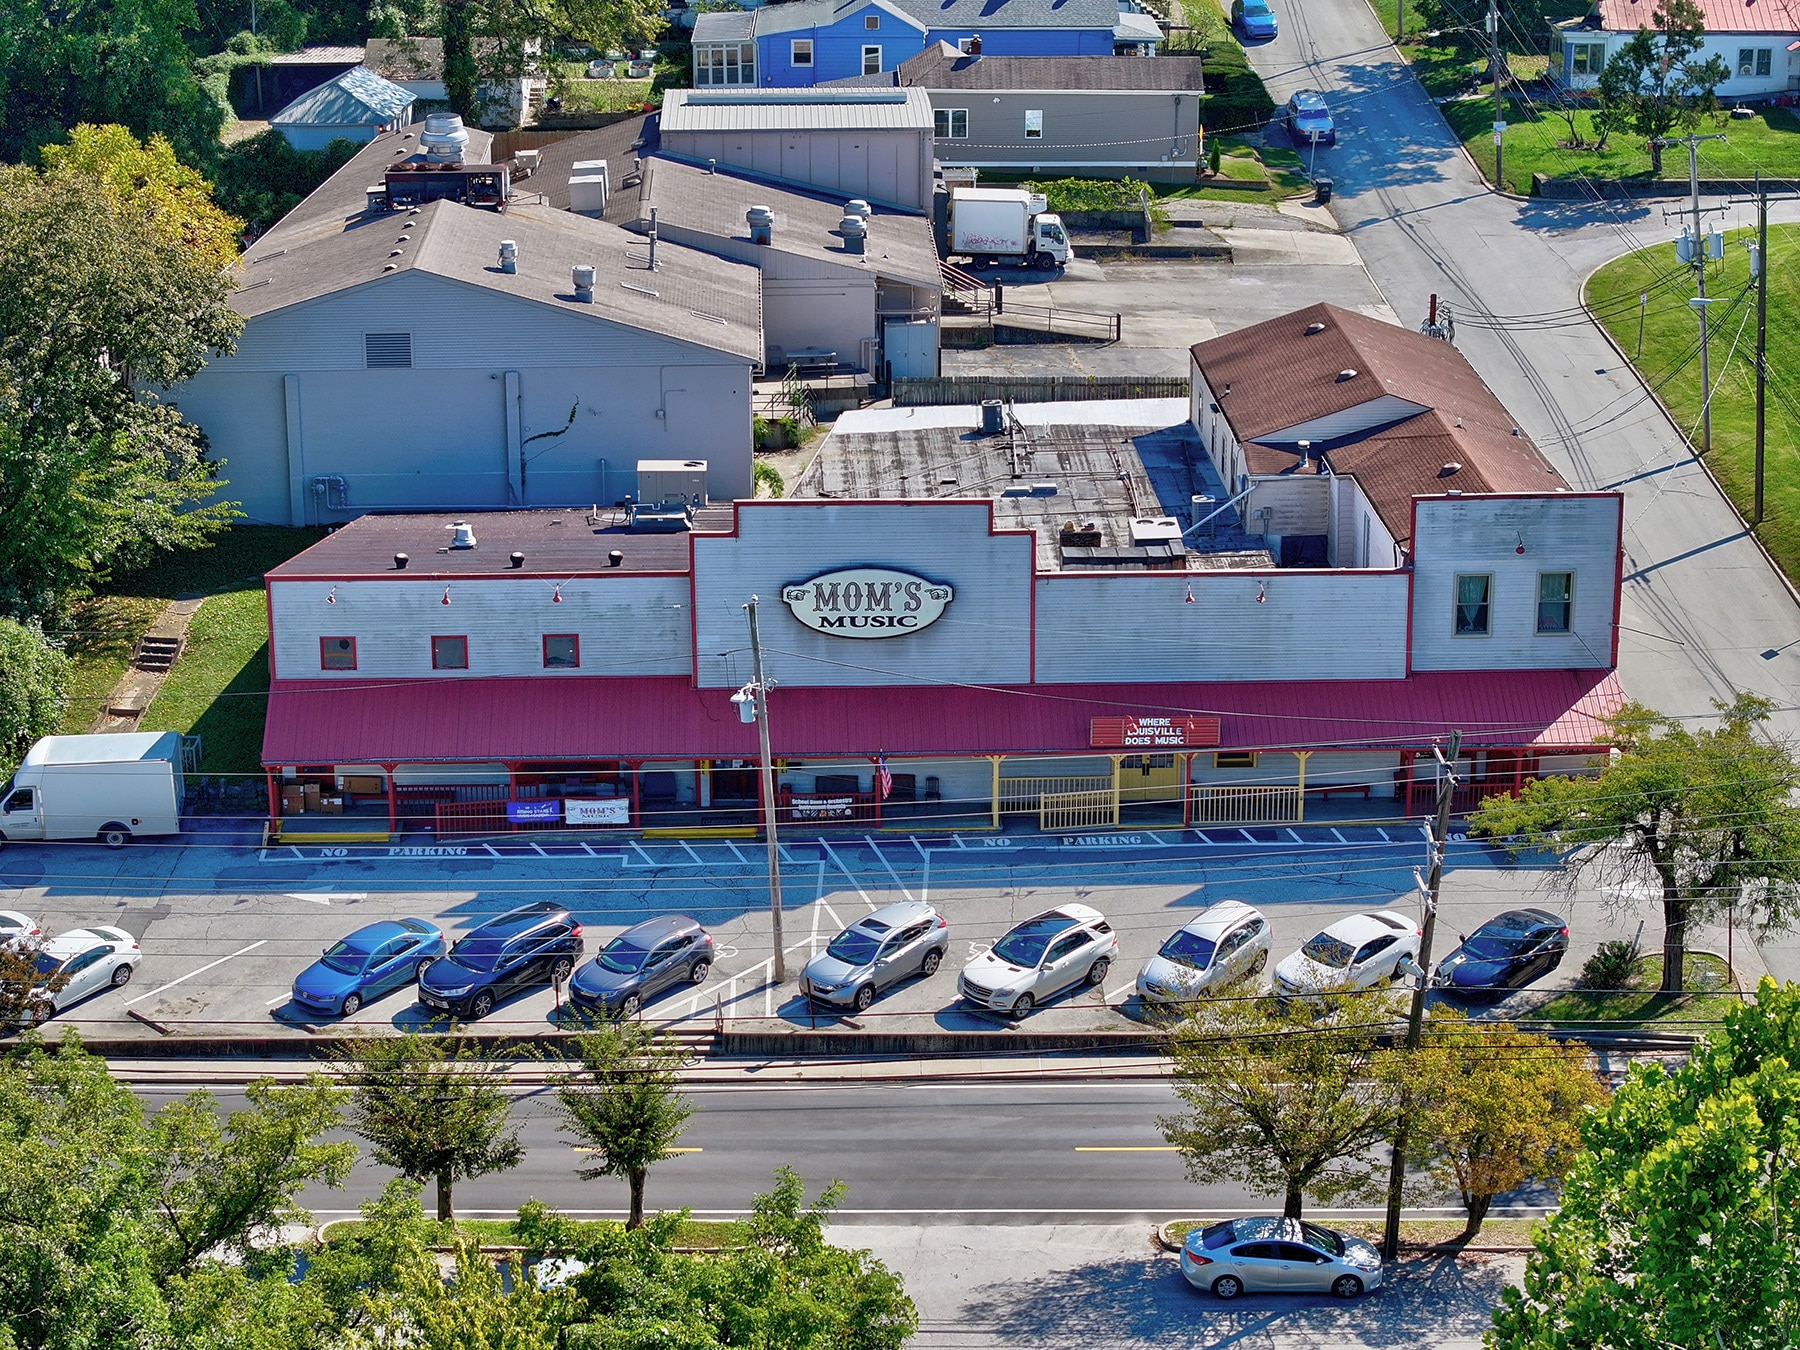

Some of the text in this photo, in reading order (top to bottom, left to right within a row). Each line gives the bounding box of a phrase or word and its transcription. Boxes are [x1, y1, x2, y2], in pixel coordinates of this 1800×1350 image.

[812, 581, 922, 612] MOM'S
[818, 615, 918, 628] MUSIC
[1138, 718, 1171, 726] WHERE
[1125, 736, 1184, 745] DOES MUSIC
[984, 836, 1141, 847] NO PARKING
[320, 847, 467, 857] NO PARKING
